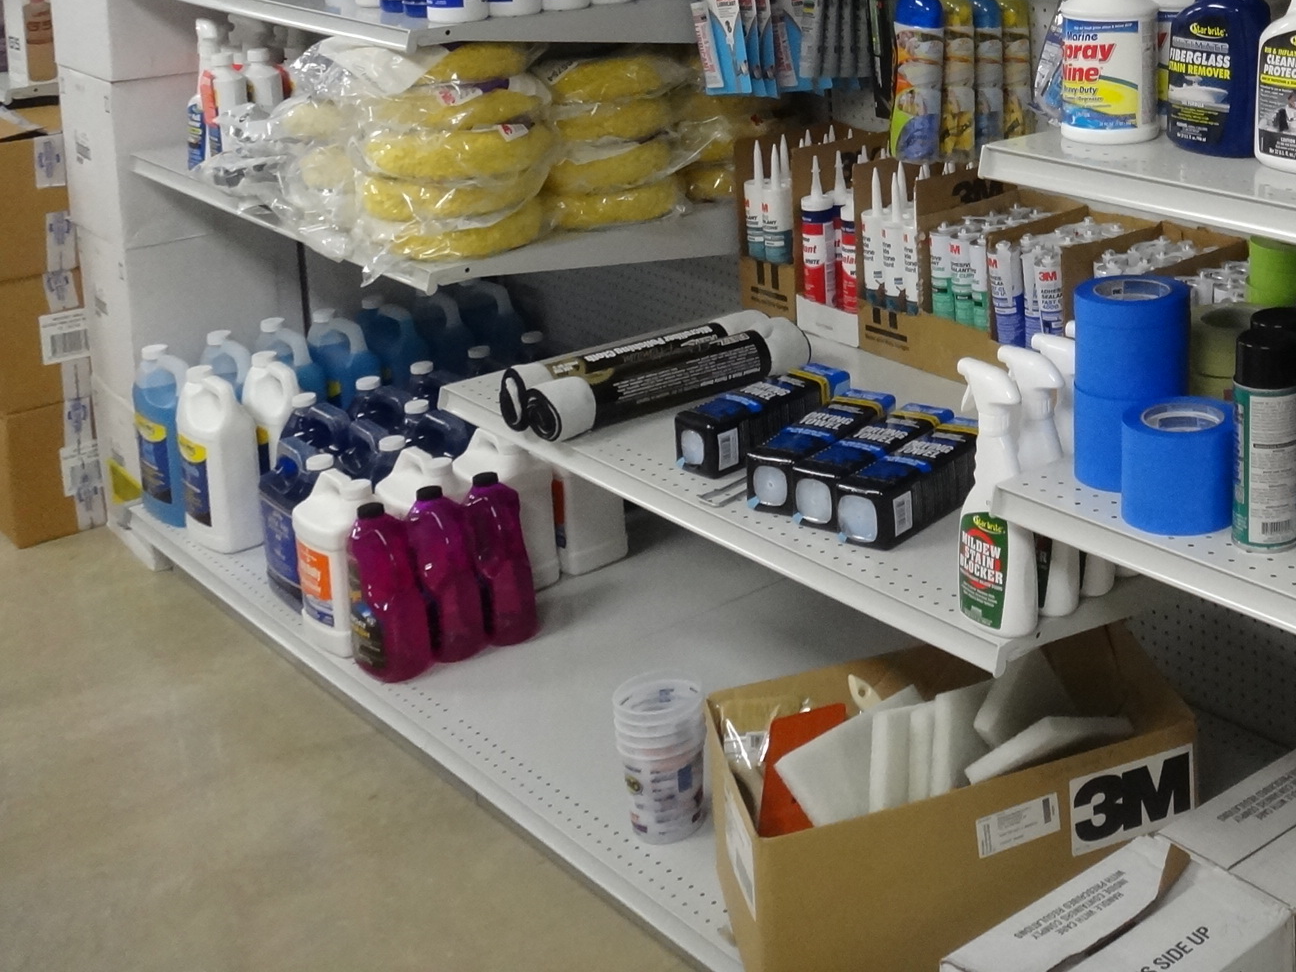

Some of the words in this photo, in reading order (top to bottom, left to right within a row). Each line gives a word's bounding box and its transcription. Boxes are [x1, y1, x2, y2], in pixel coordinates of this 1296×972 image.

[1067, 31, 1098, 42] Marine
[1169, 48, 1231, 68] FIBERGLASS
[1187, 65, 1231, 80] REMOVER
[1038, 269, 1058, 283] 3M
[799, 415, 841, 430] TOWEL
[806, 410, 855, 427] DRYING
[852, 429, 893, 445] TOWEL
[860, 425, 909, 441] DRYING
[897, 443, 938, 459] TOWEL
[905, 439, 955, 456] DRYING
[961, 530, 1002, 559] MILDEW
[964, 545, 995, 570] STAIN
[959, 553, 1003, 585] BLOCKER
[1073, 751, 1191, 842] 3M
[1152, 936, 1191, 972] SIDE
[1187, 924, 1212, 950] UP
